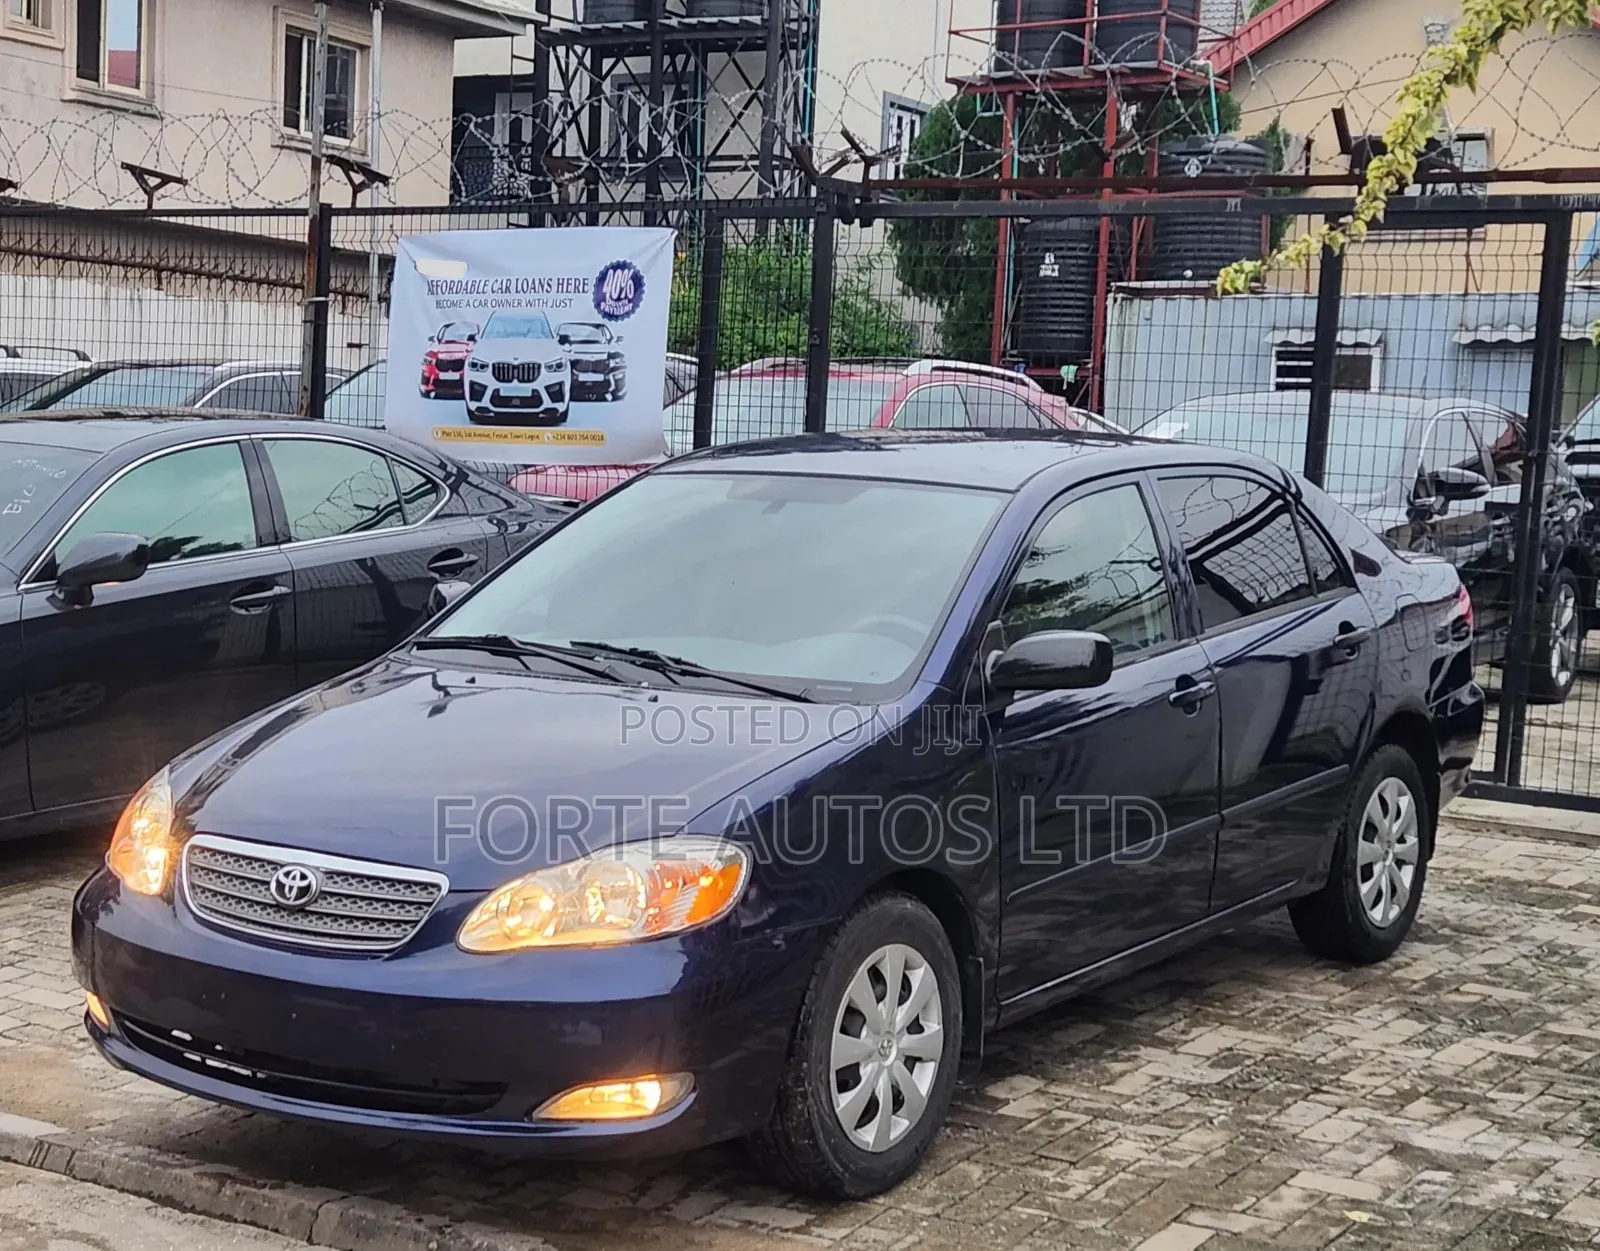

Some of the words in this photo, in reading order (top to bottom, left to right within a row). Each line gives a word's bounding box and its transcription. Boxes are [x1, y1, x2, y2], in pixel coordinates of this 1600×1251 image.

[491, 278, 512, 294] CAR
[515, 277, 553, 294] LOANS
[556, 277, 589, 294] HERE
[602, 268, 634, 300] 40%
[435, 299, 464, 309] BECOME
[465, 299, 471, 308] A
[472, 298, 489, 308] CAR
[490, 298, 523, 308] OWNER
[525, 298, 548, 308] WITH
[550, 298, 574, 308] JUST
